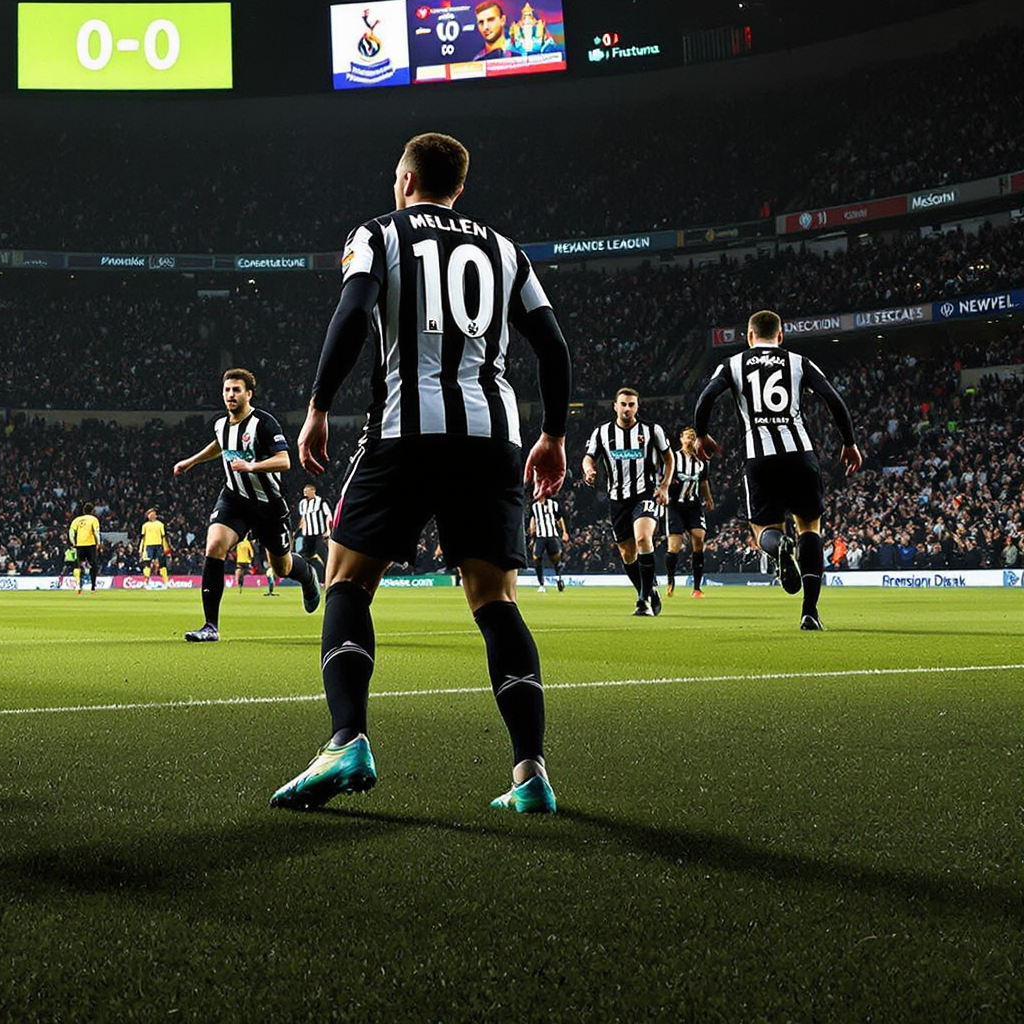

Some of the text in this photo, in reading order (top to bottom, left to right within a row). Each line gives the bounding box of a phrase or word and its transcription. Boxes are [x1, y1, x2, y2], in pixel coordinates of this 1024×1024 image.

[76, 18, 181, 71] 0-0
[408, 214, 489, 240] MELLEN
[412, 239, 495, 338] 10
[746, 369, 789, 412] 16
